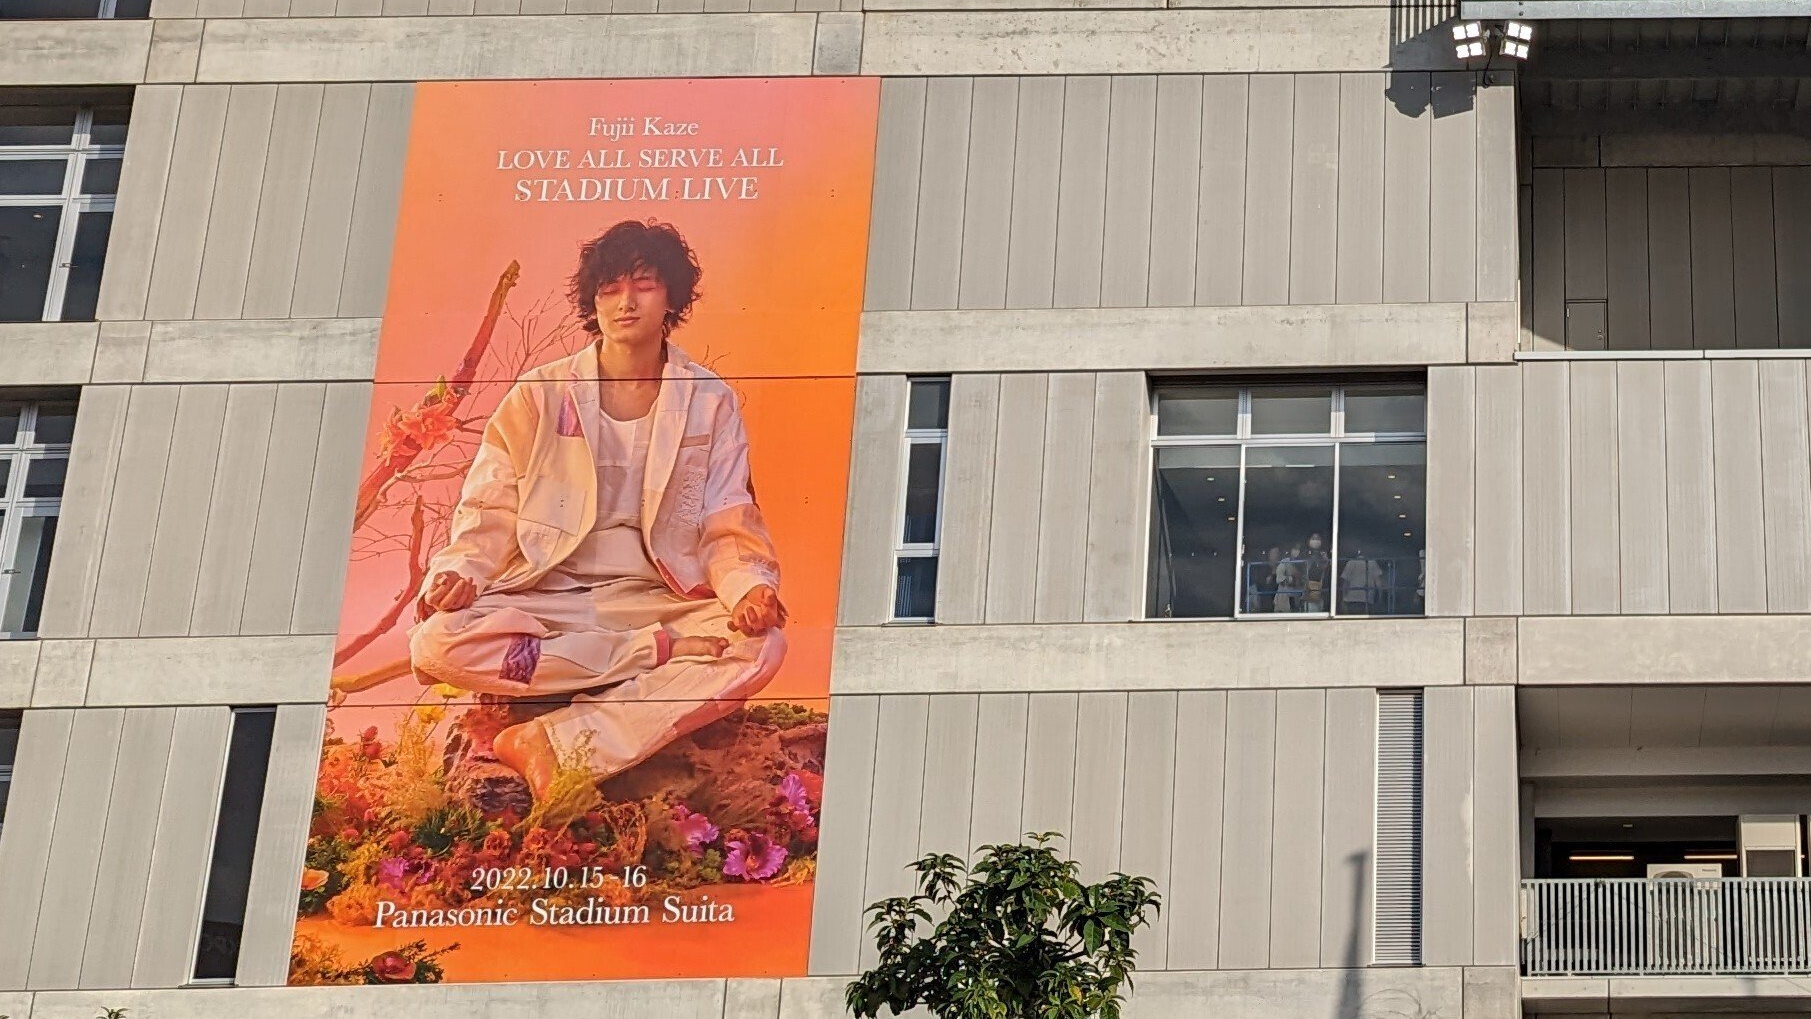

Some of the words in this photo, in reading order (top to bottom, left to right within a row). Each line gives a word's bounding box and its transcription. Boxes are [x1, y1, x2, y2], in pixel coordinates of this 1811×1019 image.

[588, 117, 635, 142] Fujii
[642, 116, 699, 136] Kaze
[497, 150, 571, 170] LOVE
[577, 149, 631, 169] ALL
[638, 148, 724, 168] SERVE
[730, 147, 784, 167] ALL
[514, 178, 670, 202] STADIUM
[679, 176, 759, 201] LIVE
[470, 865, 647, 891] 2022.10.15-16
[372, 898, 518, 929] Panasonic
[529, 896, 650, 925] Stadium
[662, 895, 735, 923] Suita
